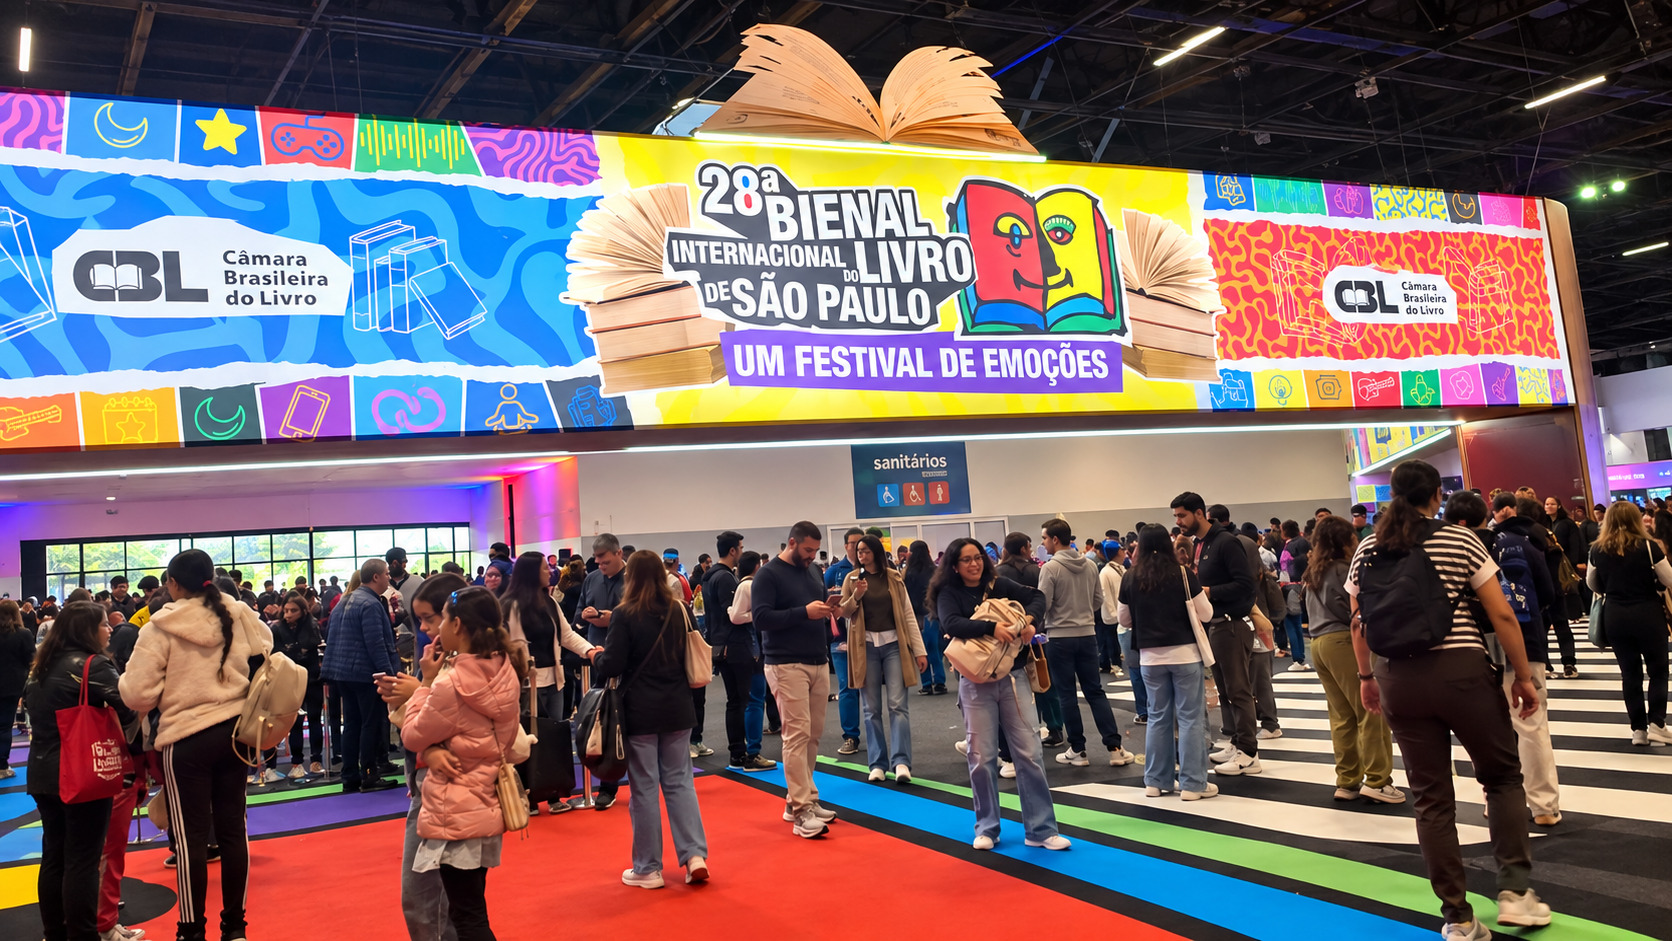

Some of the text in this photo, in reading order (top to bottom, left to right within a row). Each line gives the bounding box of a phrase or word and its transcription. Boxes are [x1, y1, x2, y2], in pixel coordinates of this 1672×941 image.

[764, 190, 930, 241] BIENAL
[222, 250, 307, 267] Câmara
[671, 239, 973, 284] INTERNACIONAL DO LIVRO
[73, 250, 209, 302] CBL
[224, 269, 329, 287] Brasileira
[1401, 281, 1437, 291] Câmara
[225, 290, 318, 306] do Livro
[705, 271, 931, 325] DE SÃO PAULO
[1334, 280, 1400, 314] CBL
[1404, 293, 1447, 303] Brasileira
[1406, 305, 1444, 315] do Livro
[732, 342, 1109, 386] UM FESTIVAL DE EMOÇÕES
[873, 453, 947, 470] sanitários
